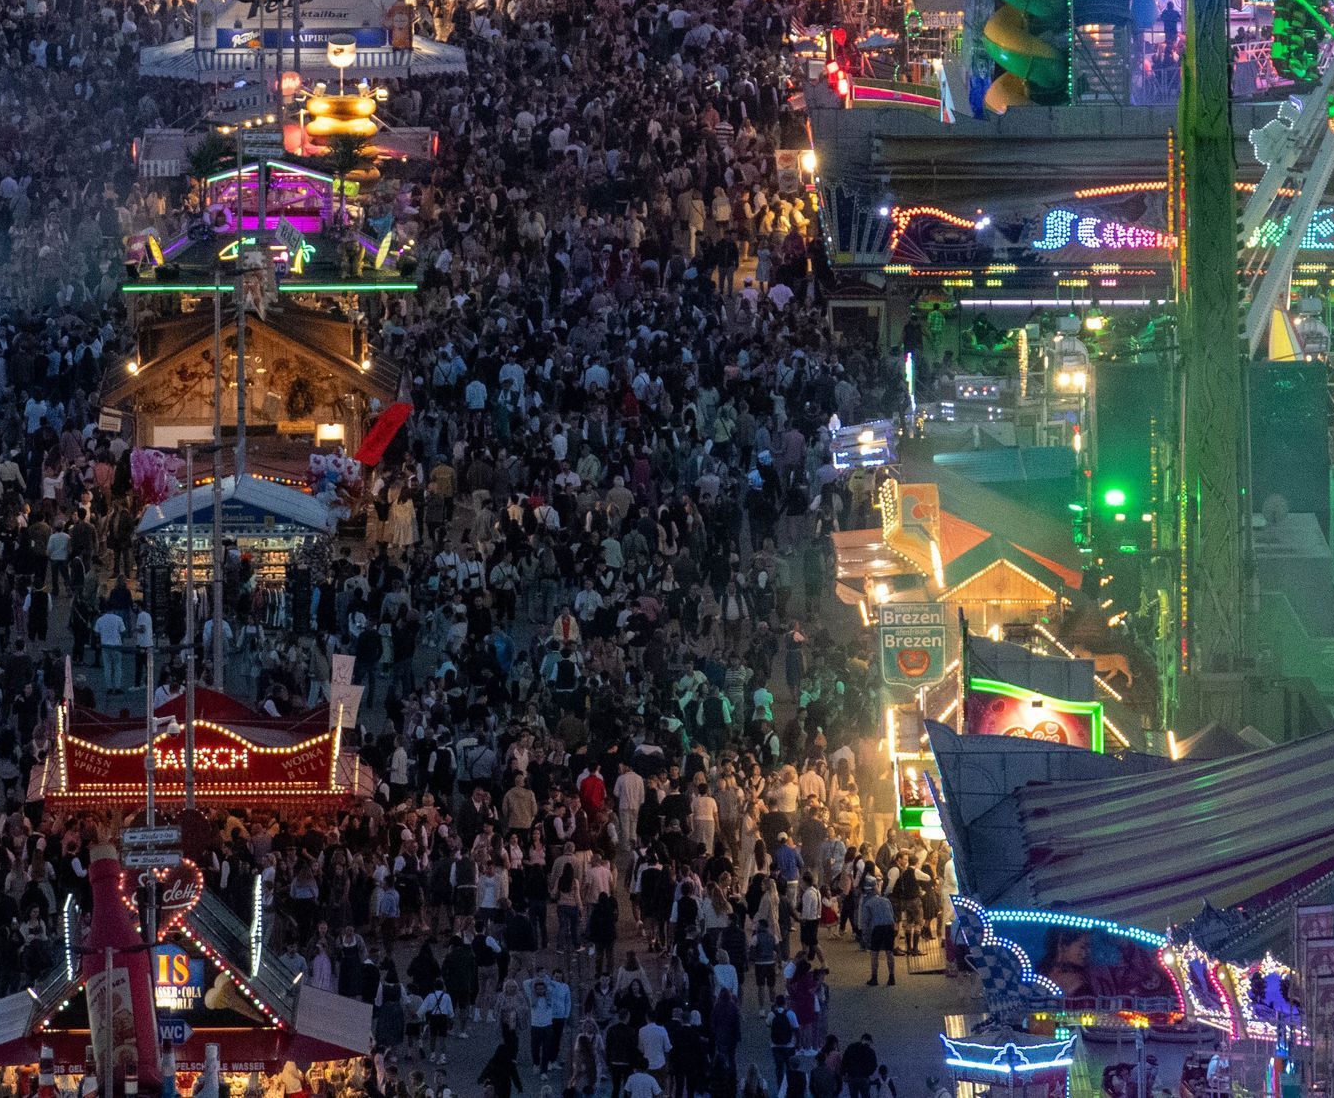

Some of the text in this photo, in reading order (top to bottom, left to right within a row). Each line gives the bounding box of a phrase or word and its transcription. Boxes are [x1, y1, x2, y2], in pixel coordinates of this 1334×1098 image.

[883, 611, 940, 625] Brezen
[884, 634, 942, 648] Brezen
[74, 749, 111, 769] WIESN
[281, 747, 323, 770] WODKA
[73, 760, 108, 778] SPRITZ
[286, 758, 327, 781] BULL
[160, 1025, 183, 1039] WC
[231, 1062, 265, 1071] WASSER
